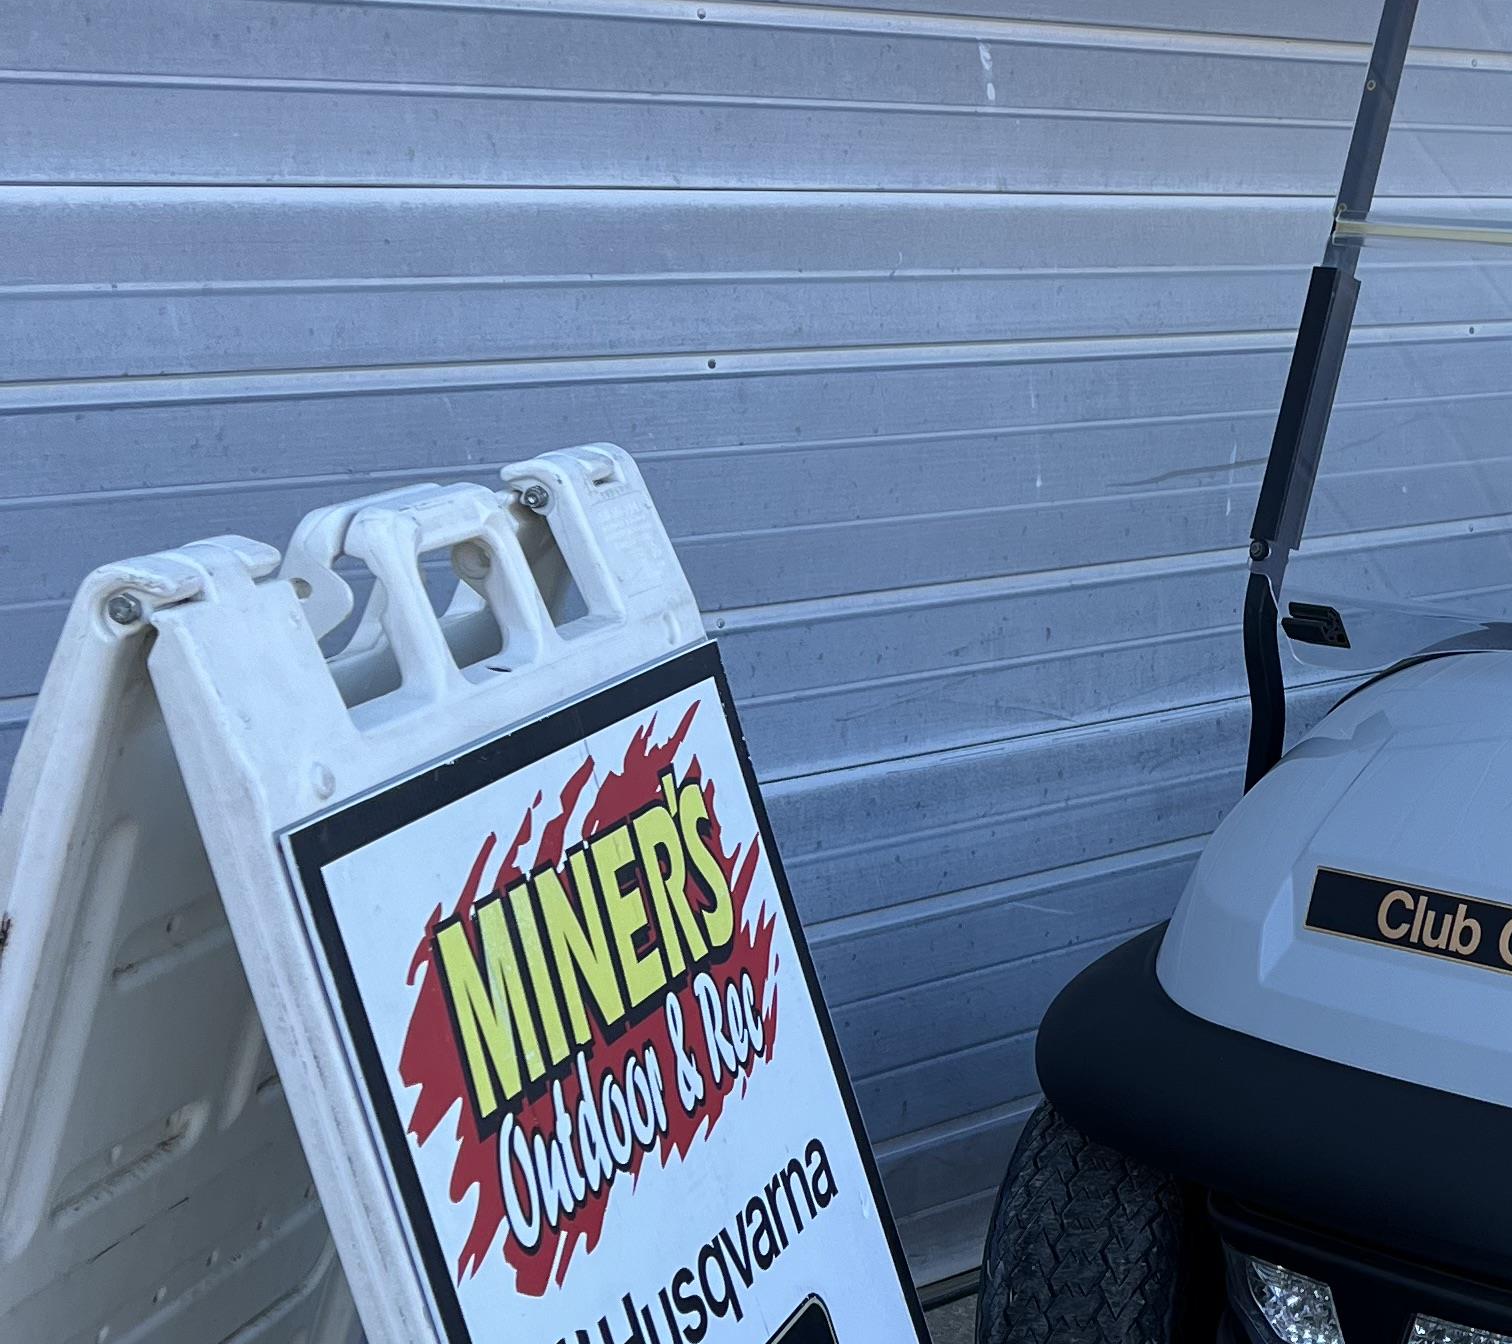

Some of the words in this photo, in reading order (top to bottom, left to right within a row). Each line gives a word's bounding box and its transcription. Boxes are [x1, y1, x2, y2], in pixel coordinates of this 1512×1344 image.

[434, 770, 735, 1121] MINER'S
[1376, 889, 1482, 956] Club
[498, 1050, 669, 1251] Outdoor
[665, 991, 704, 1113] &
[694, 970, 766, 1086] Rec
